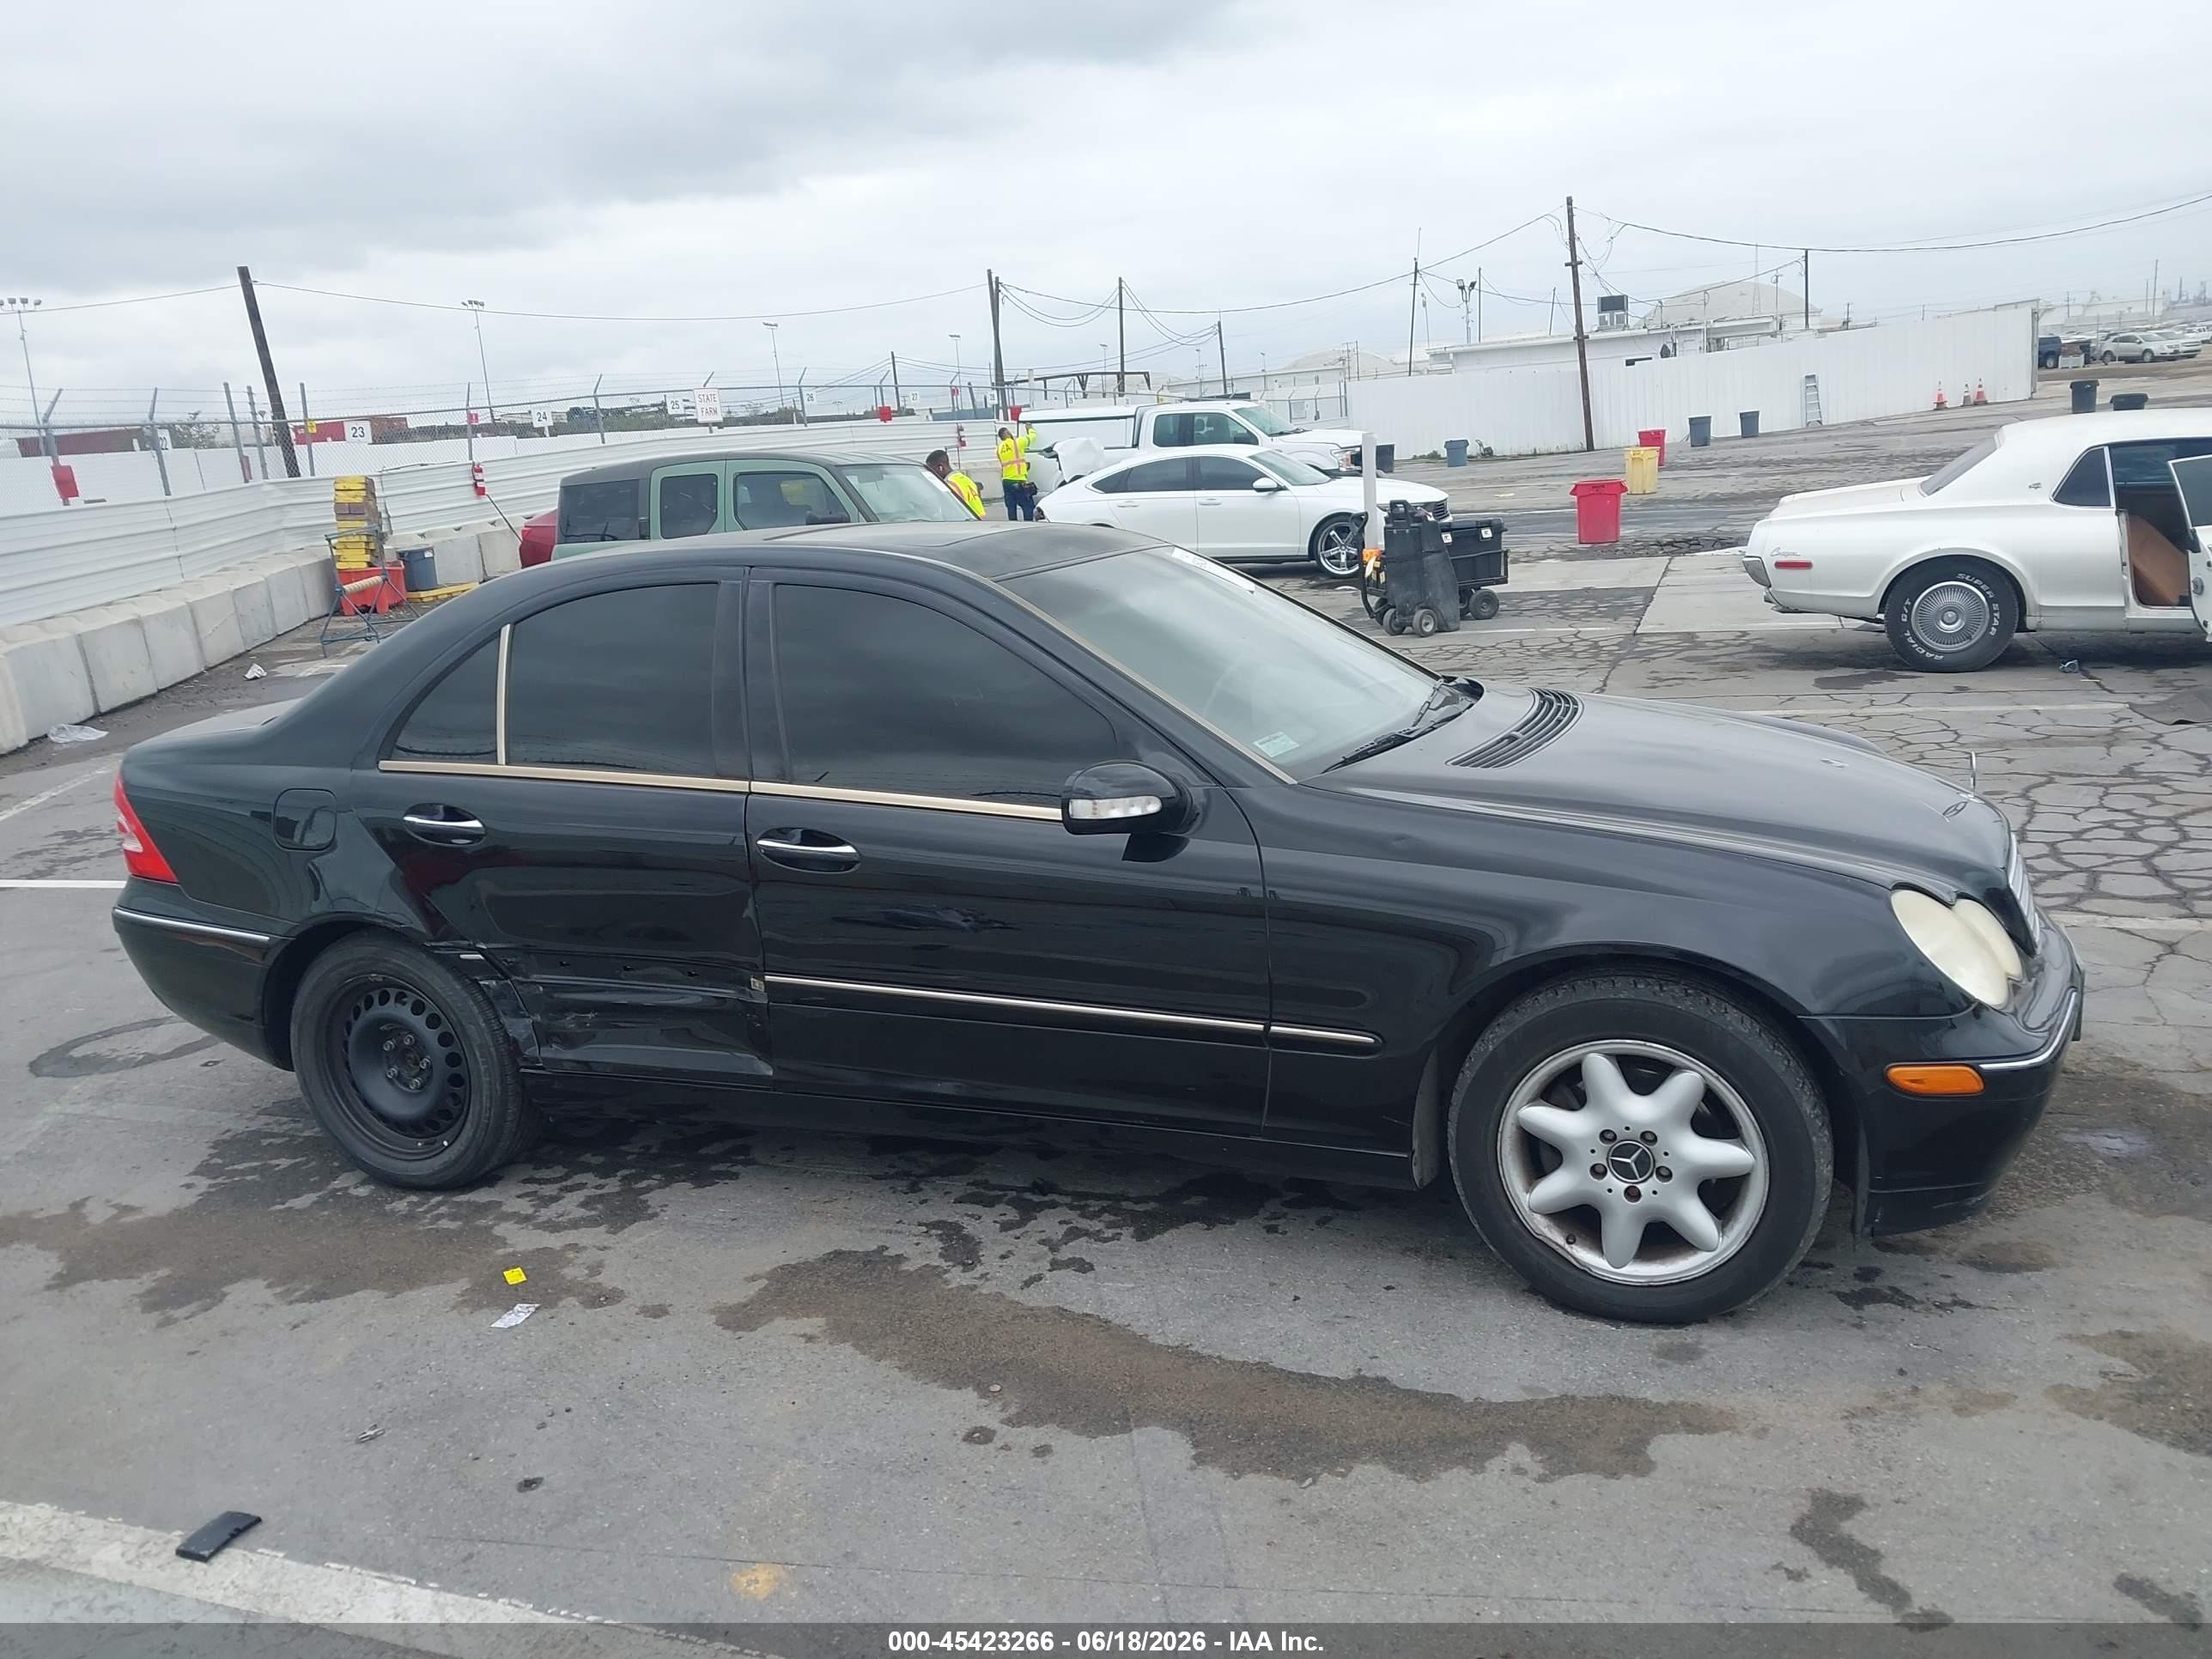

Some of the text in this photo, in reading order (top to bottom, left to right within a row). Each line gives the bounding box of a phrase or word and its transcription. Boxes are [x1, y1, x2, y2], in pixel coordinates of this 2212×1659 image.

[697, 393, 718, 404] STATE
[806, 392, 815, 402] 26
[670, 400, 680, 410] 25
[536, 411, 548, 422] 24
[700, 406, 719, 417] FARM
[350, 426, 366, 438] 23
[159, 436, 169, 451] 22
[1956, 573, 2001, 636] SUPER STAR
[1904, 629, 1945, 660] RADIAL
